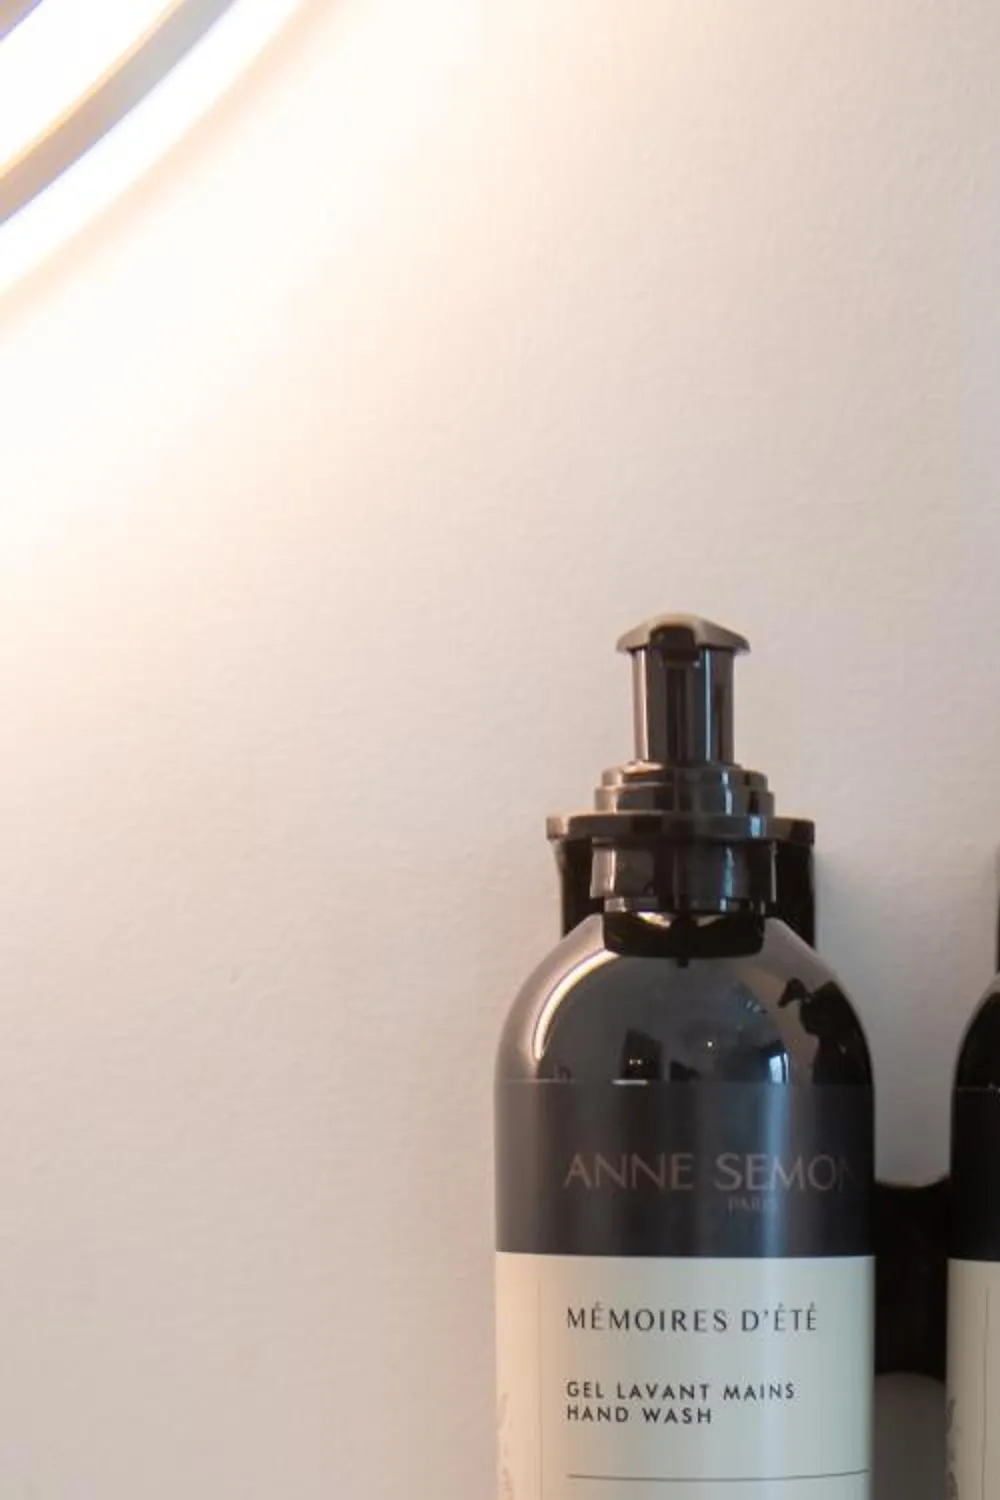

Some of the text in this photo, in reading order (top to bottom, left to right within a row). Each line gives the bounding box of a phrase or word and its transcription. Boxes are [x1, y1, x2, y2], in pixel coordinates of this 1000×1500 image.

[564, 1152, 694, 1189] ANNE
[727, 1197, 777, 1212] PARI
[566, 1302, 728, 1332] MÉMOIRES
[566, 1381, 796, 1401] GEL LAVANT MAINS
[566, 1406, 712, 1425] HAND WASH
